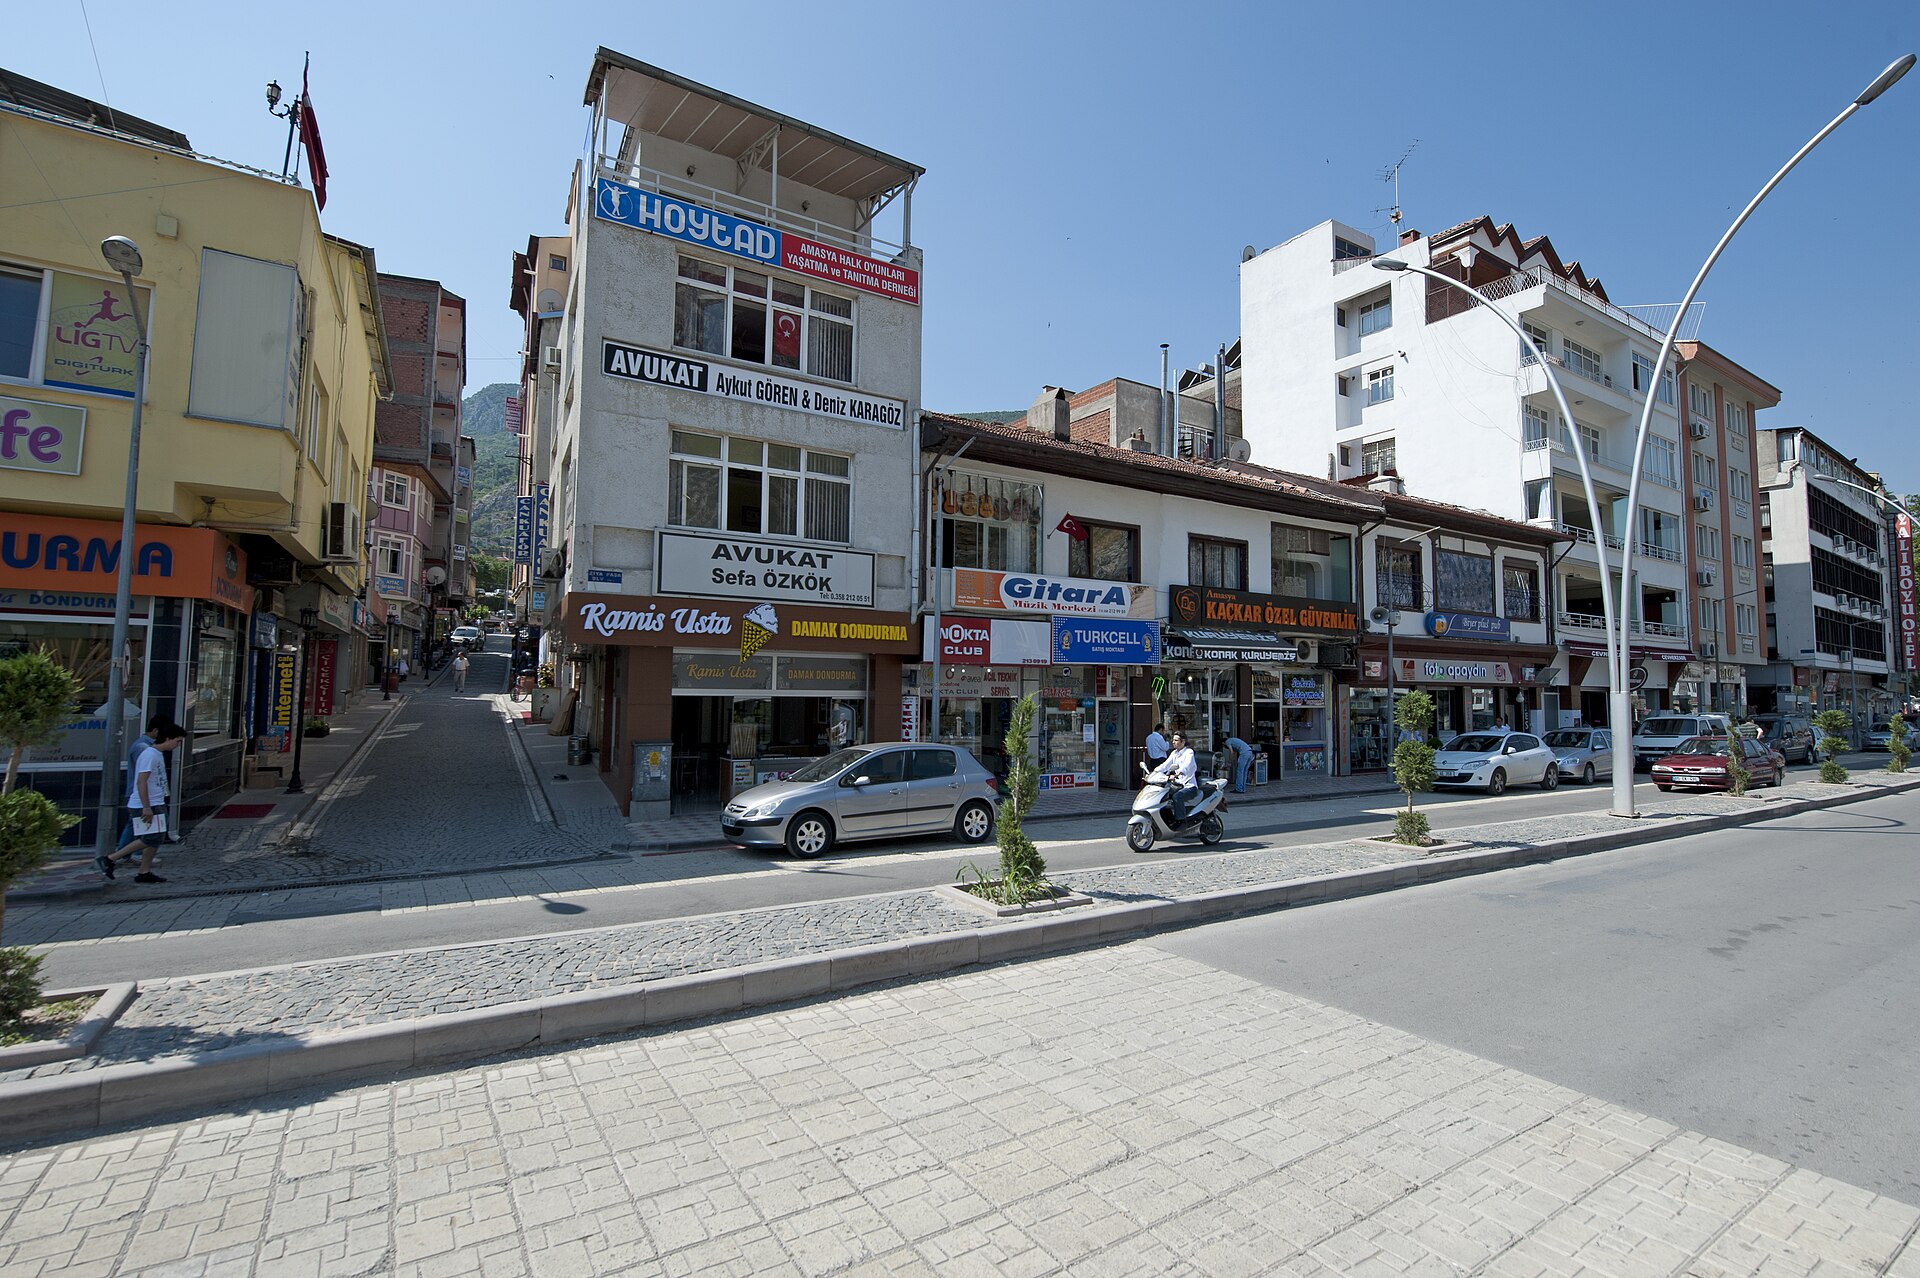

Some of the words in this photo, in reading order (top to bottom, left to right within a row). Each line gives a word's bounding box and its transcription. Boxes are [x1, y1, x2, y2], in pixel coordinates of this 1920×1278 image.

[800, 243, 837, 261] AMASYA
[839, 253, 861, 269] HALK
[864, 259, 905, 282] OYUNLARI
[787, 253, 828, 275] YAŞATMA
[830, 267, 841, 277] ve
[843, 268, 879, 289] TANITMA
[881, 277, 916, 298] DERNEĞİ
[610, 349, 704, 388] AVUKAT
[716, 373, 752, 399] Aykut
[756, 377, 798, 407] GÖREN
[801, 393, 811, 408] &
[814, 392, 846, 416] Deniz
[850, 400, 901, 426] KARAGÖZ
[2, 531, 173, 577] URMA
[711, 544, 833, 570] AVUKAT
[711, 568, 756, 587] Sefa
[763, 572, 832, 592] ÖZKÖK
[1004, 577, 1125, 606] GitarA
[29, 594, 135, 609] DONDURM
[1012, 600, 1048, 610] Müzik
[1051, 602, 1097, 613] Merkezi
[1206, 589, 1236, 601] Amasya
[580, 602, 666, 637] Ramis
[670, 608, 732, 635] Usta
[791, 620, 838, 639] DAMAK
[840, 623, 907, 641] DONDURMA
[1206, 601, 1261, 624] KAÇKAR
[1264, 602, 1296, 626] ÖZEL
[1300, 606, 1357, 630] GÜVENLİK
[1491, 619, 1501, 632] pub
[939, 624, 989, 643] NOKTA
[1075, 629, 1140, 645] TURKCELL
[1902, 619, 1916, 669] OTEL
[944, 646, 983, 656] CLUB
[686, 663, 725, 680] Ramis
[728, 665, 758, 679] Usta
[788, 669, 814, 680] DAMAK
[816, 670, 856, 681] DONDURMA
[1424, 662, 1444, 676] foto
[1447, 664, 1487, 679] apaydın
[273, 661, 293, 727] internet
[990, 685, 1010, 696] SERVİS
